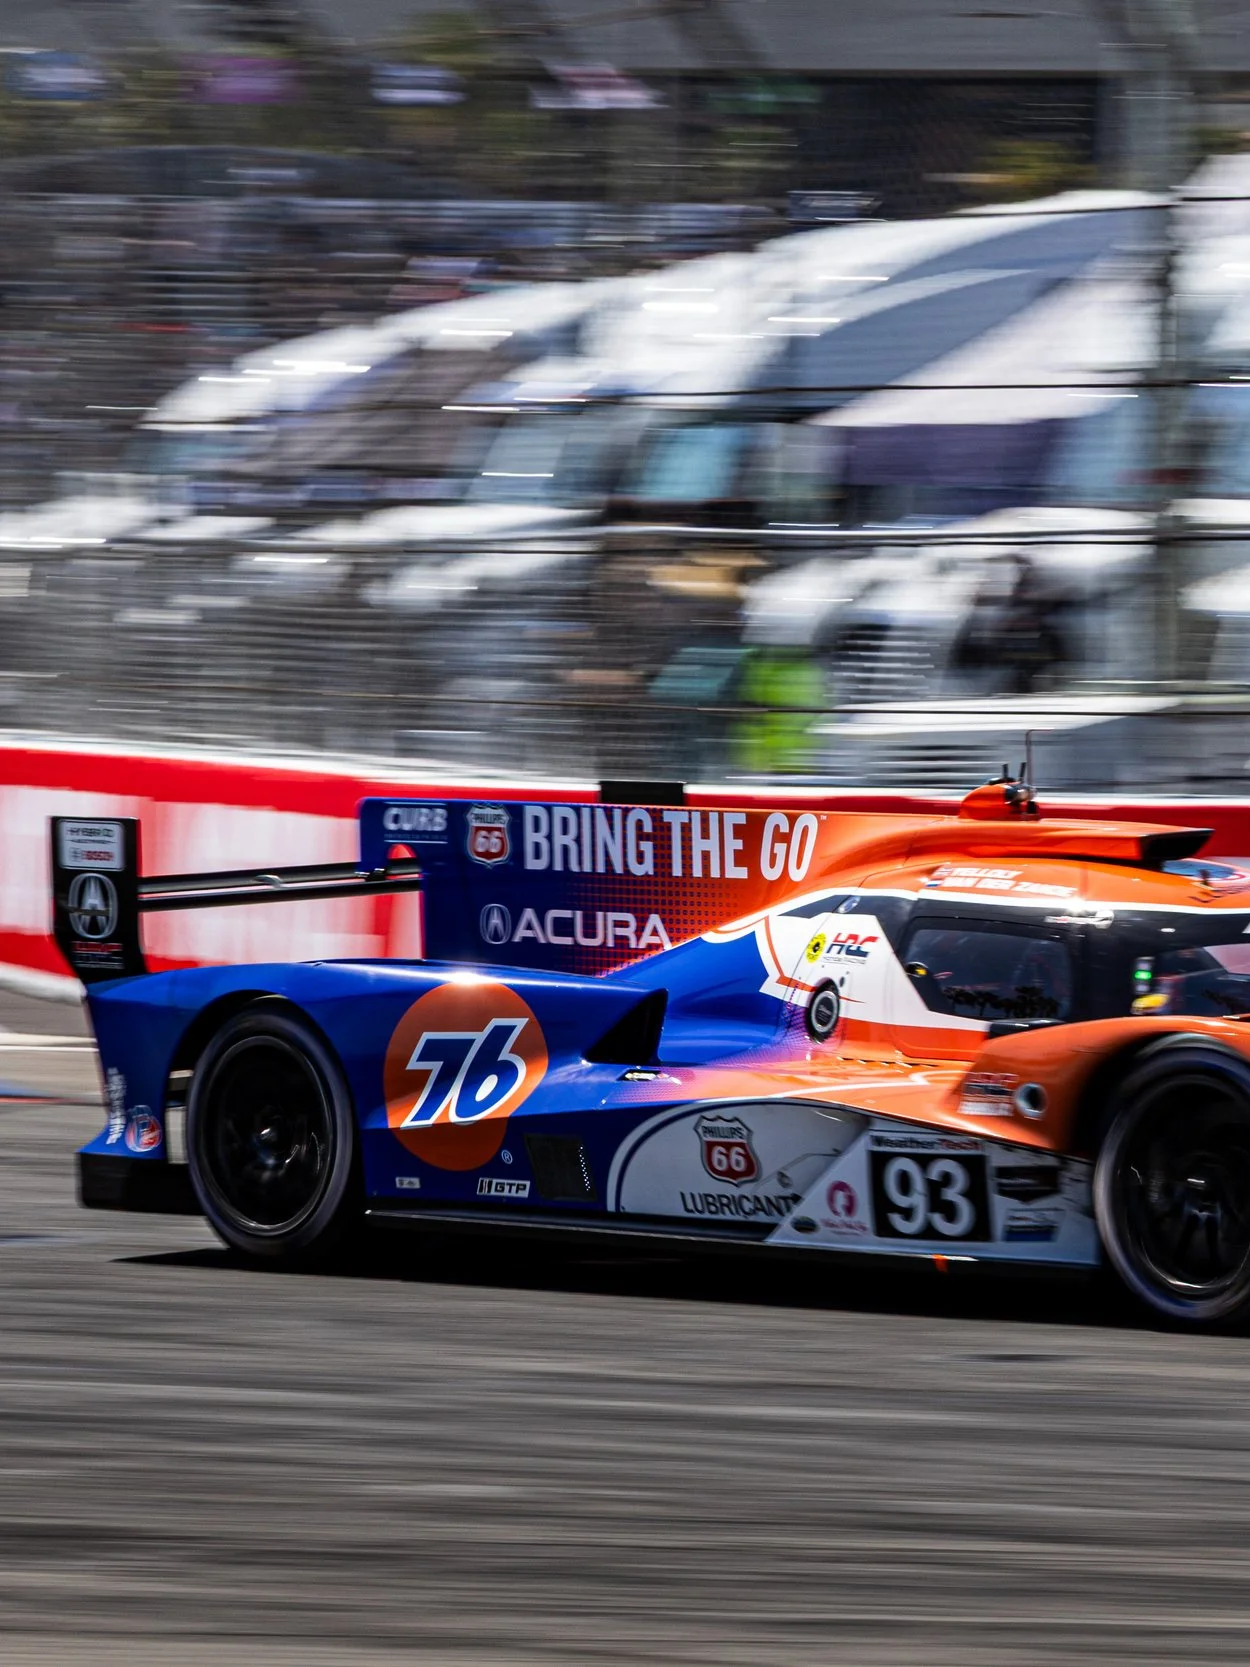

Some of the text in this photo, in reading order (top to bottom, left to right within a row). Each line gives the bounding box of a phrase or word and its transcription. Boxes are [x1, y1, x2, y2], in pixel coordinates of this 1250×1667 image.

[383, 807, 448, 831] CURB
[474, 830, 503, 853] 66
[523, 805, 655, 876] BRING
[663, 811, 748, 879] THE
[760, 812, 818, 882] GO
[511, 907, 673, 950] ACURA
[400, 1017, 529, 1129] 76
[701, 1124, 744, 1140] PHILLIPS
[711, 1145, 748, 1172] 66
[493, 1181, 527, 1194] GTP
[884, 1156, 977, 1237] 93
